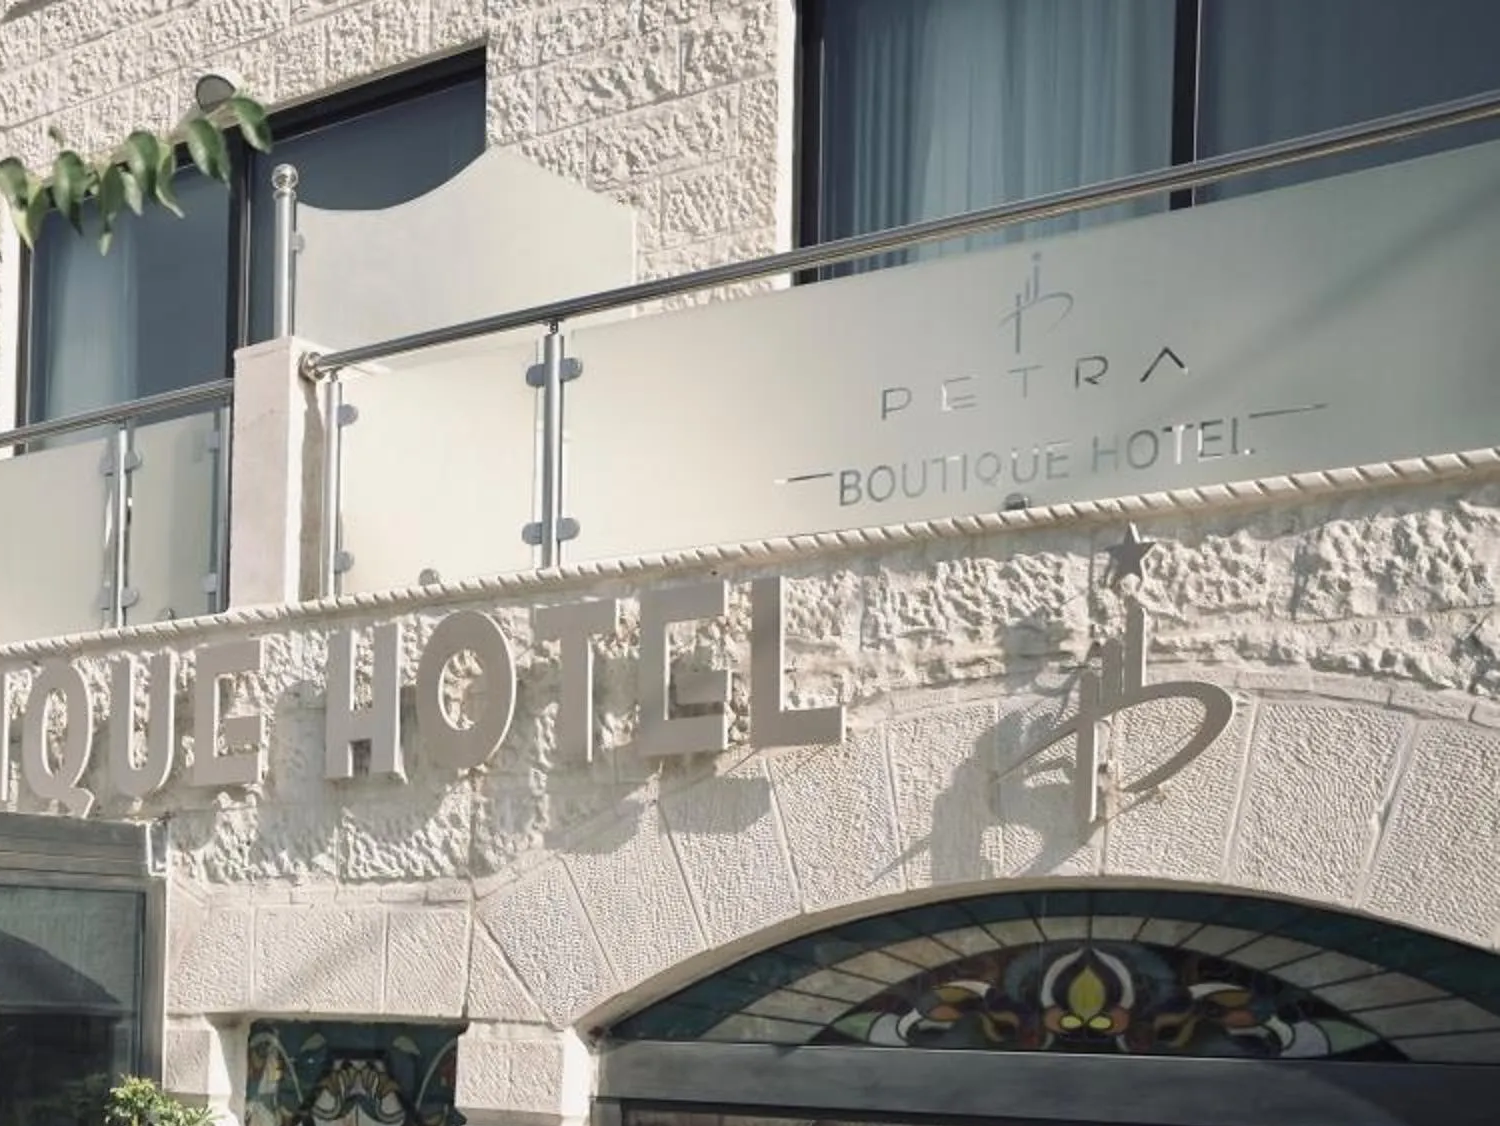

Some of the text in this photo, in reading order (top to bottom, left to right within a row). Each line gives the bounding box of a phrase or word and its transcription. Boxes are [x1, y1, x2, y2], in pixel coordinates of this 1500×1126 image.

[881, 347, 1188, 420] PETRA
[839, 417, 1255, 507] BOUTIQUE HOTEL
[325, 575, 845, 784] HOTEL
